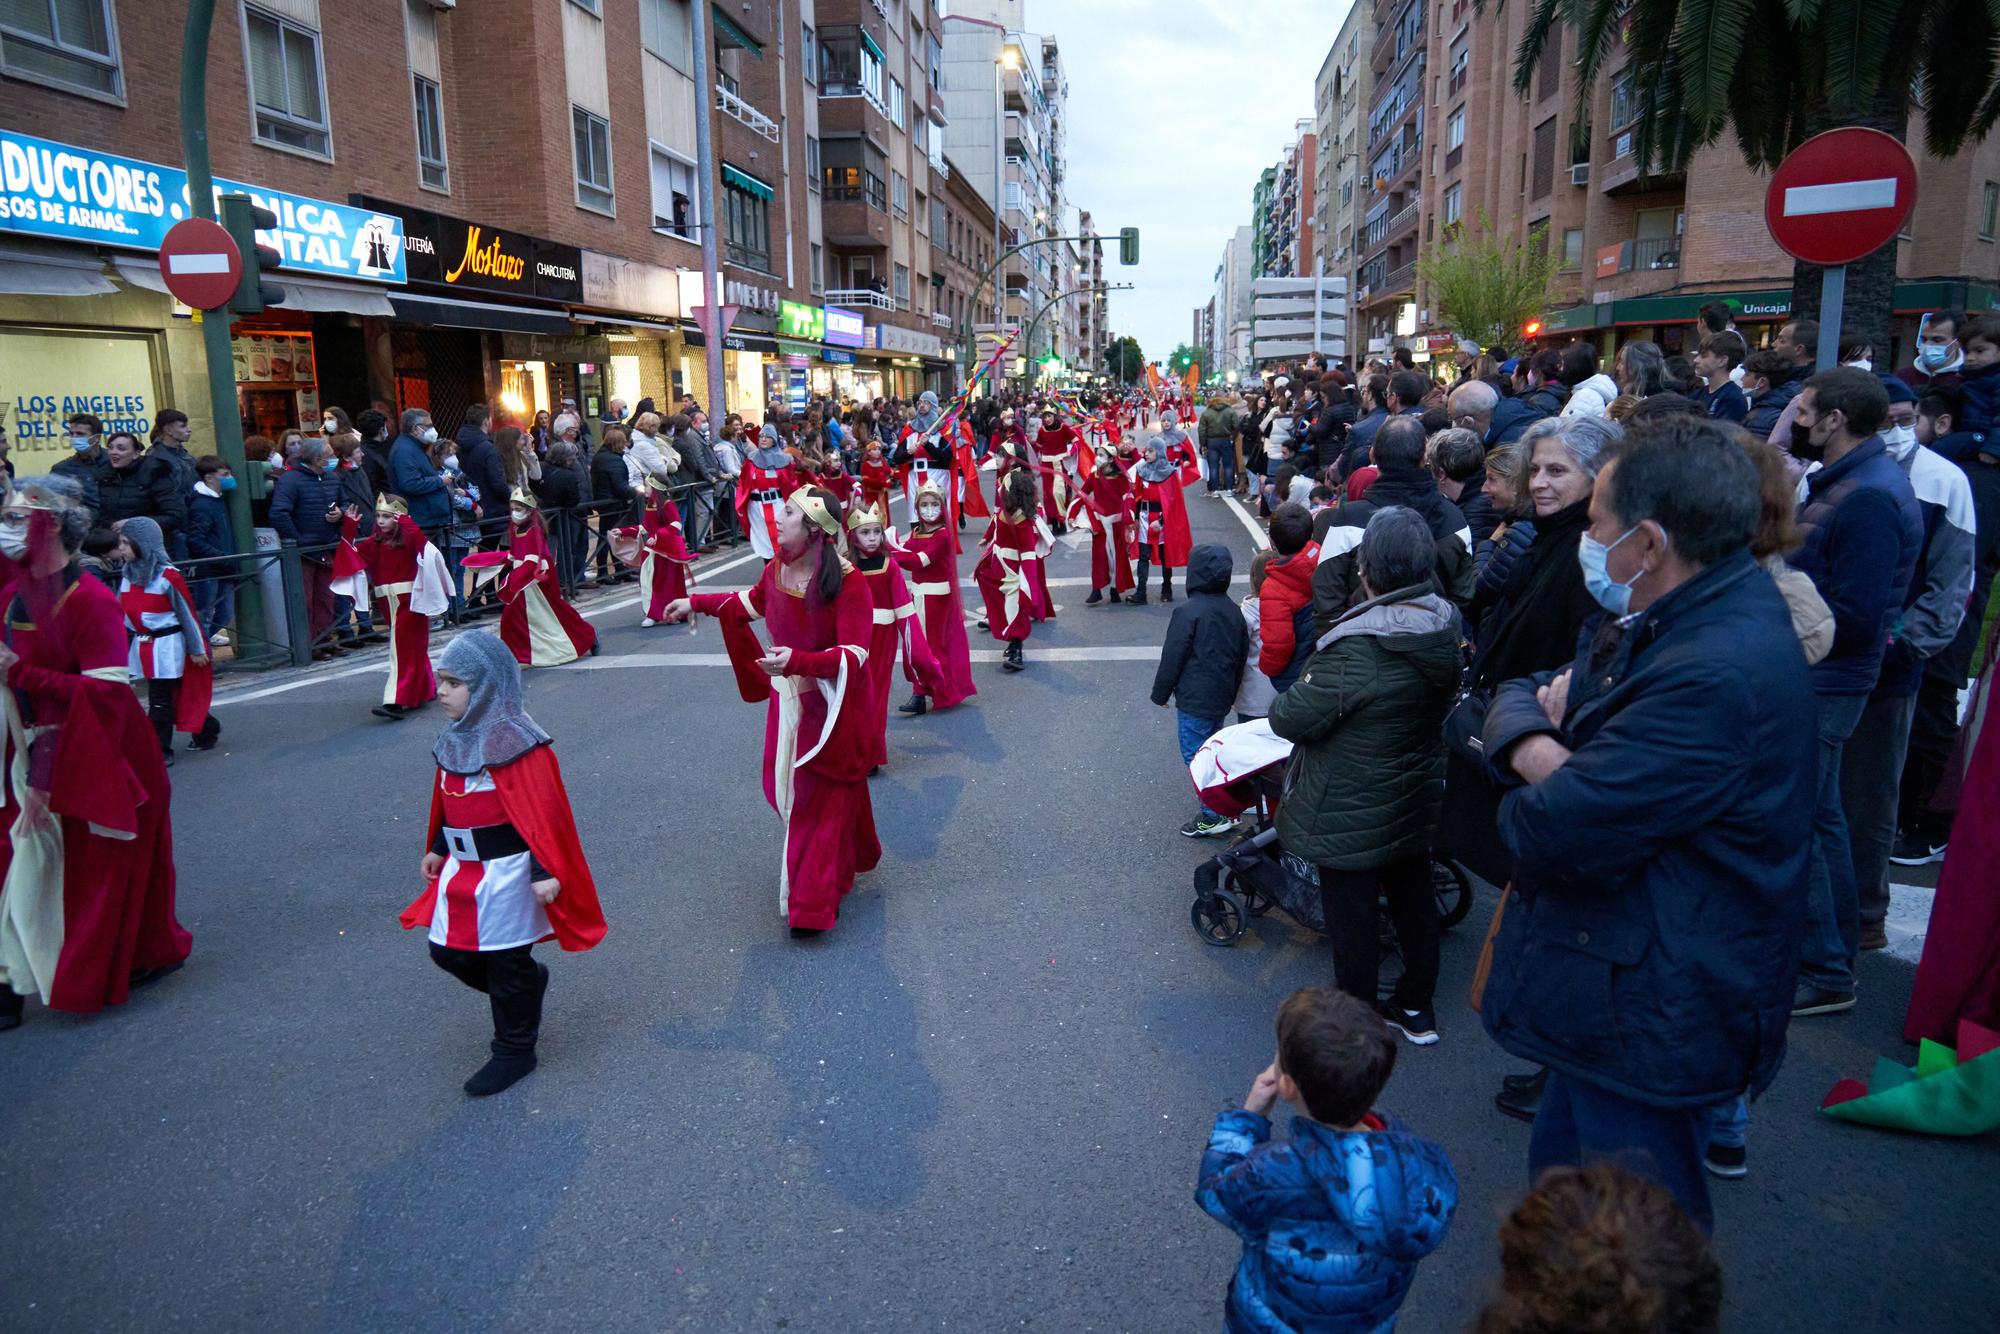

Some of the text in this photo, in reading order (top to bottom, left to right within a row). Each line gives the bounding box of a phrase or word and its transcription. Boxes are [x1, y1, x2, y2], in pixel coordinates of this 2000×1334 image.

[0, 140, 164, 217] DUCTORES
[40, 201, 65, 224] DE
[446, 226, 524, 282] Mostazo
[537, 262, 576, 281] CHARCUTERÍA
[1744, 303, 1786, 314] Unicaja
[18, 396, 144, 413] LOS ANGELES
[18, 418, 149, 438] DEL SORRO
